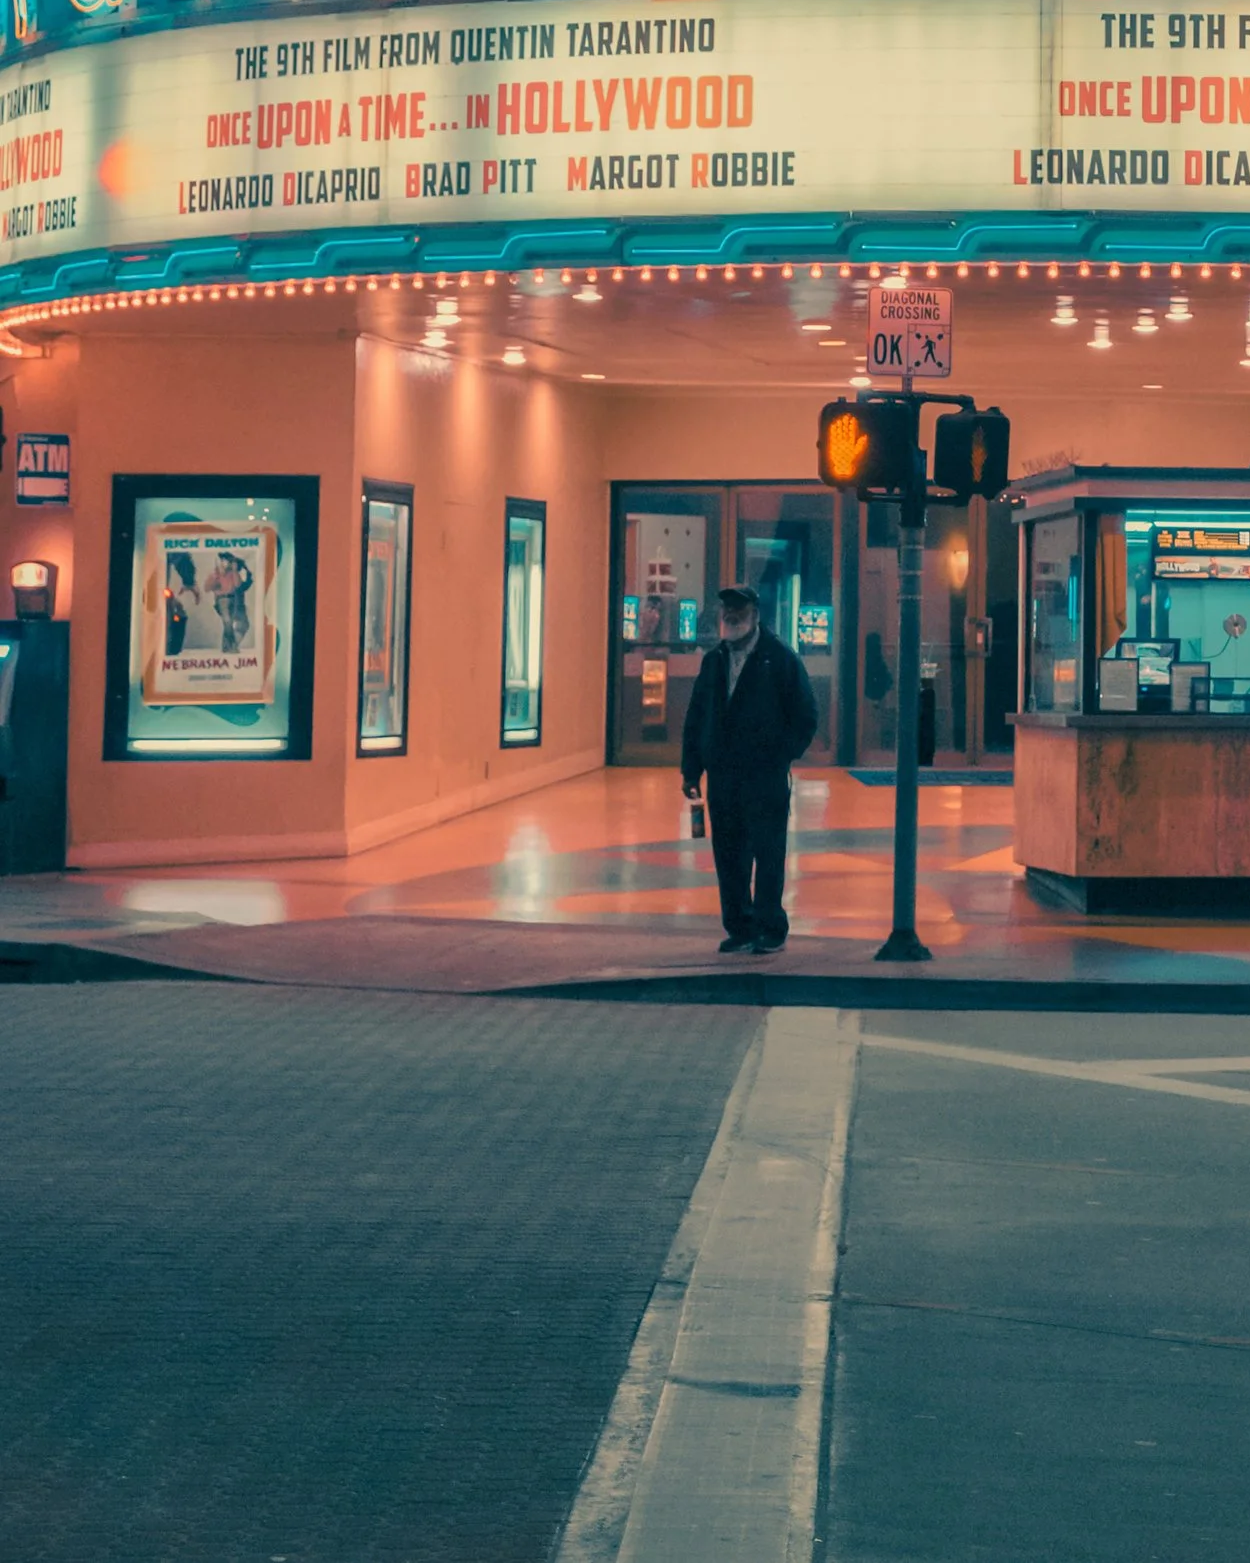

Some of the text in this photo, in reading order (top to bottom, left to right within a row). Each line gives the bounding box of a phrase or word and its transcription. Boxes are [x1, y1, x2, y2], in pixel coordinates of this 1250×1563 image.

[1101, 13, 1155, 48] THE
[1168, 14, 1225, 49] 9TH
[236, 18, 715, 81] THE 9TH FILM FROM QUENTIN TARANTINO
[7, 79, 51, 122] TARANTINO
[207, 74, 754, 149] ONCE UPON A TIME... IN HOLLYWOOD
[1059, 81, 1132, 116] ONCE
[179, 151, 795, 214] LEONARDO DICAPRIO BRAD PITT MARGOT ROBBIE
[1013, 149, 1169, 185] LEONARDO
[37, 196, 77, 234] ROBBIE
[881, 291, 939, 305] DIAGONAL
[881, 306, 940, 320] CROSSING
[874, 333, 902, 365] OK
[18, 443, 69, 472] ATM
[164, 536, 259, 549] RICK DALTON
[162, 657, 258, 672] NEBRASKA JIM
